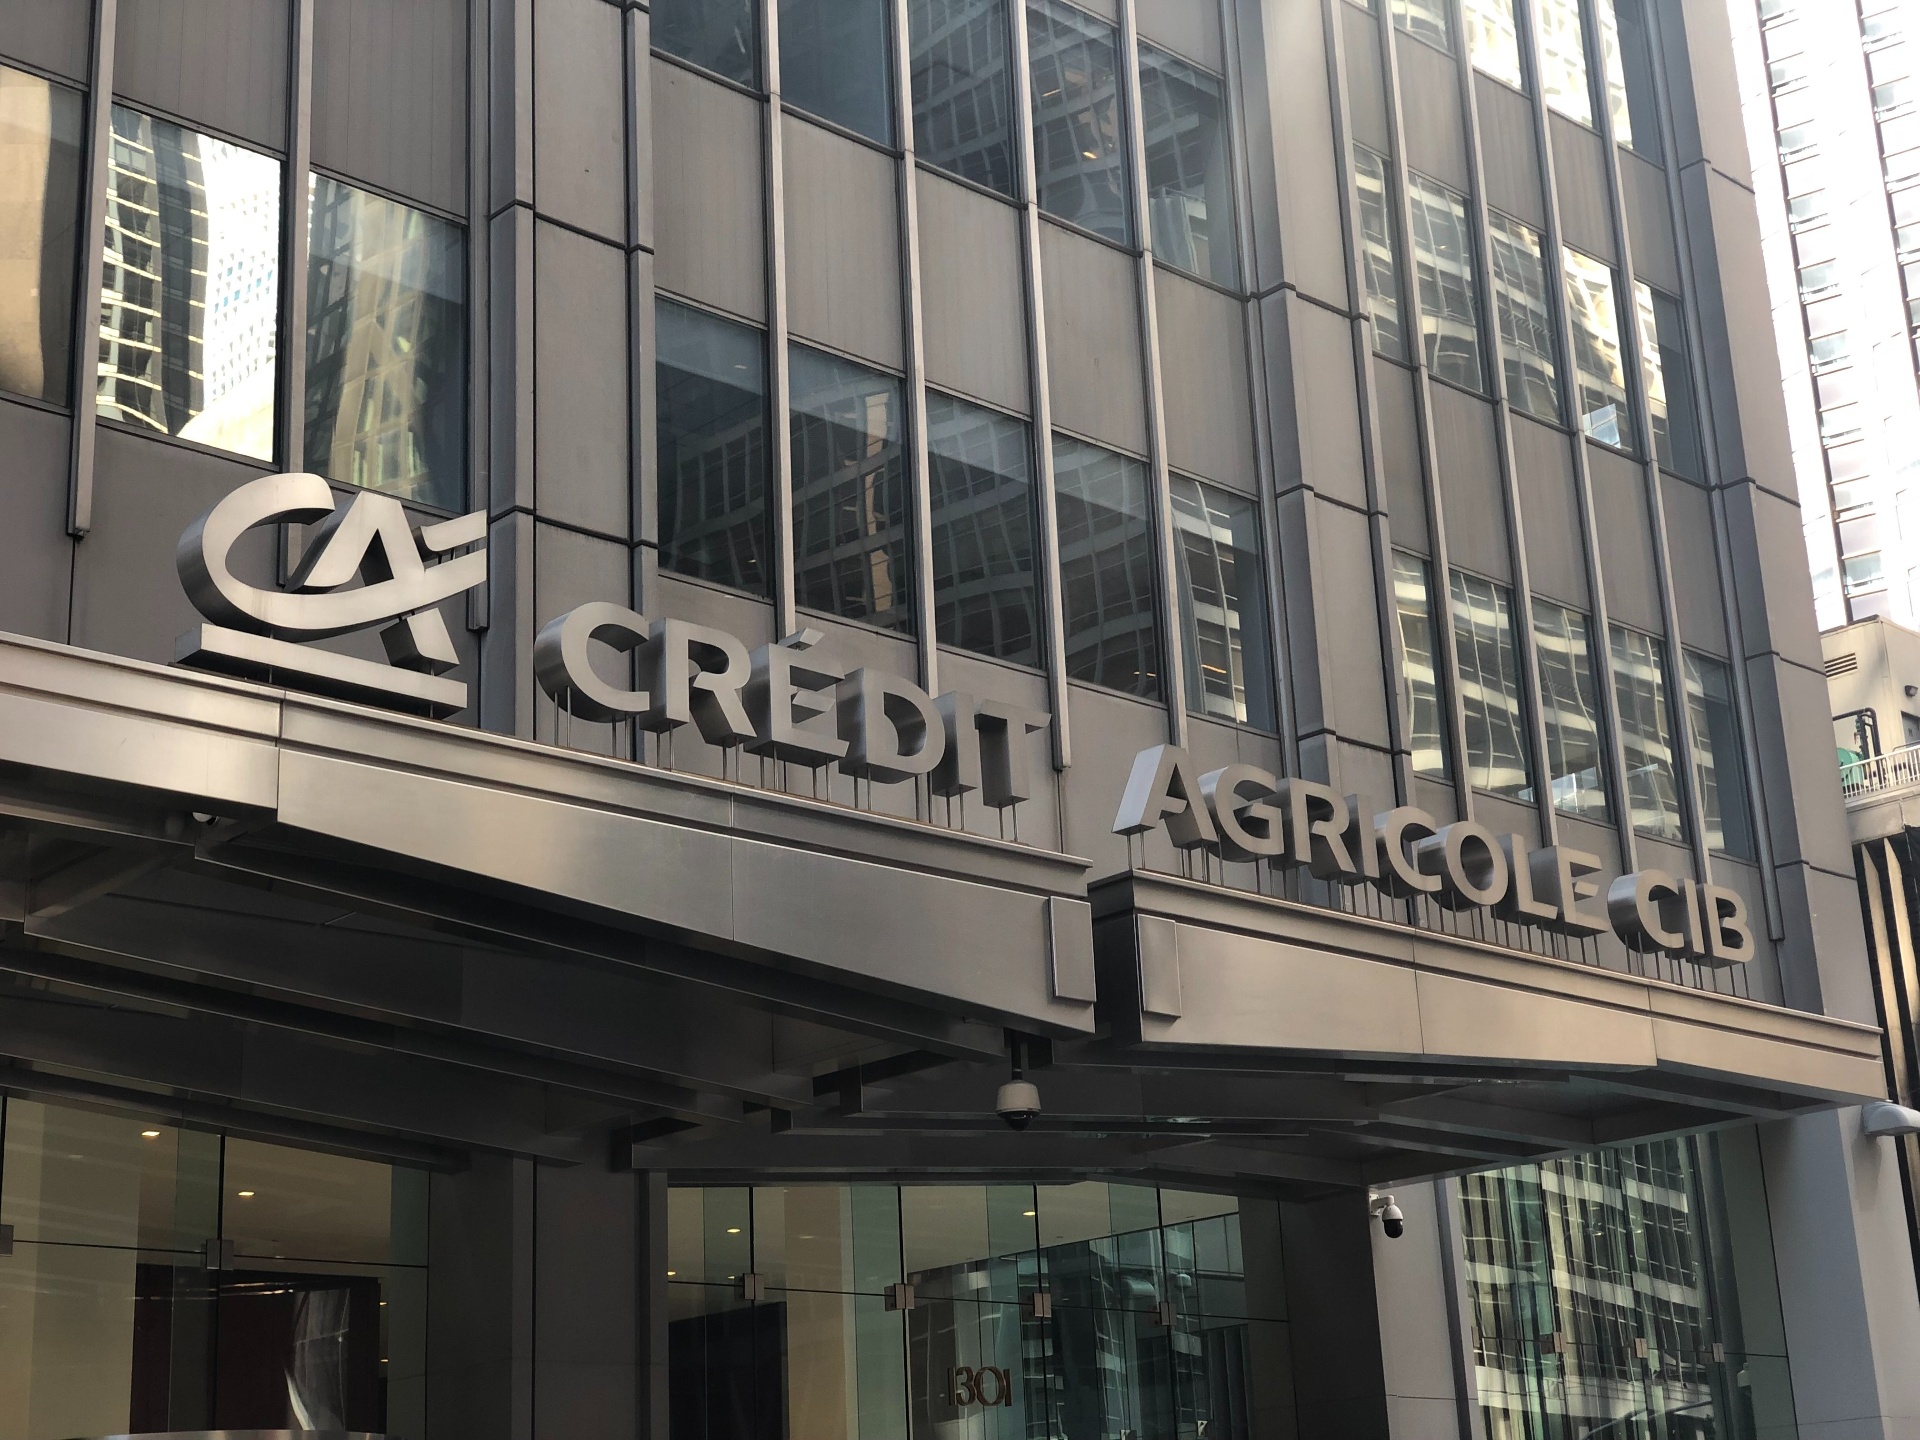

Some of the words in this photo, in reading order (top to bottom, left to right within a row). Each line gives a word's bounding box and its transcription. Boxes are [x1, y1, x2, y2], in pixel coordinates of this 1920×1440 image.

[534, 601, 1051, 807] CRÉDIT
[1112, 743, 1609, 938] AGRICOLE
[1607, 869, 1755, 967] CIB
